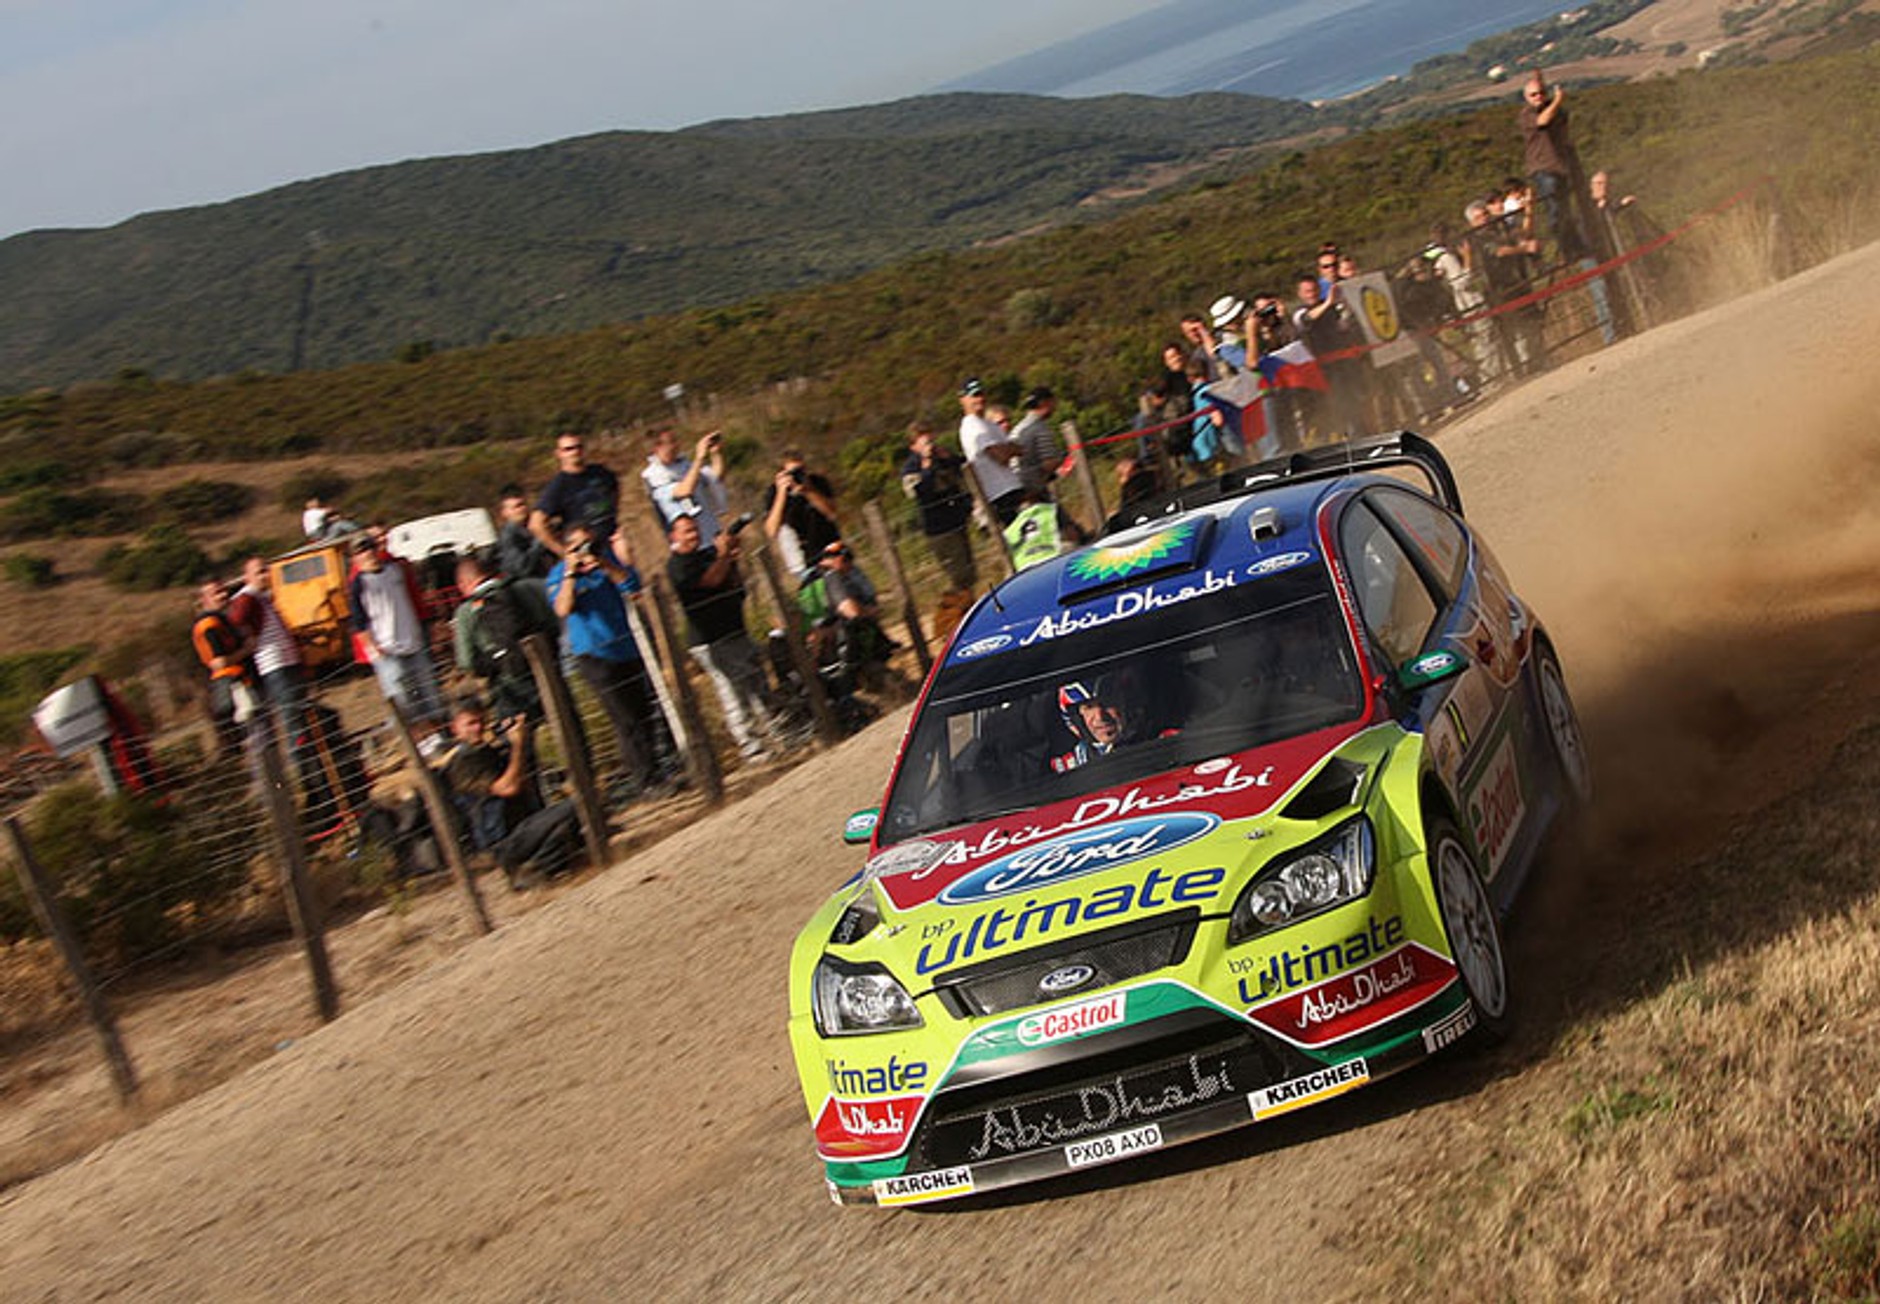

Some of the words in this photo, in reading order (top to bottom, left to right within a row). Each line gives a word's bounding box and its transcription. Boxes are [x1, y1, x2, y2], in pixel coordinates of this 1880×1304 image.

[1116, 571, 1236, 621] Dhabi
[1071, 765, 1275, 825] Dhabi
[985, 824, 1167, 893] Ford
[916, 867, 1225, 976] ultimate
[921, 919, 955, 941] bp
[1227, 957, 1254, 974] bp
[1238, 915, 1405, 1004] ultimate
[1354, 954, 1416, 1005] Dhabi
[1044, 999, 1118, 1038] Castrol
[1080, 1054, 1236, 1130] Dhabi
[1069, 1139, 1115, 1164] PX08
[1120, 1128, 1160, 1150] AXD
